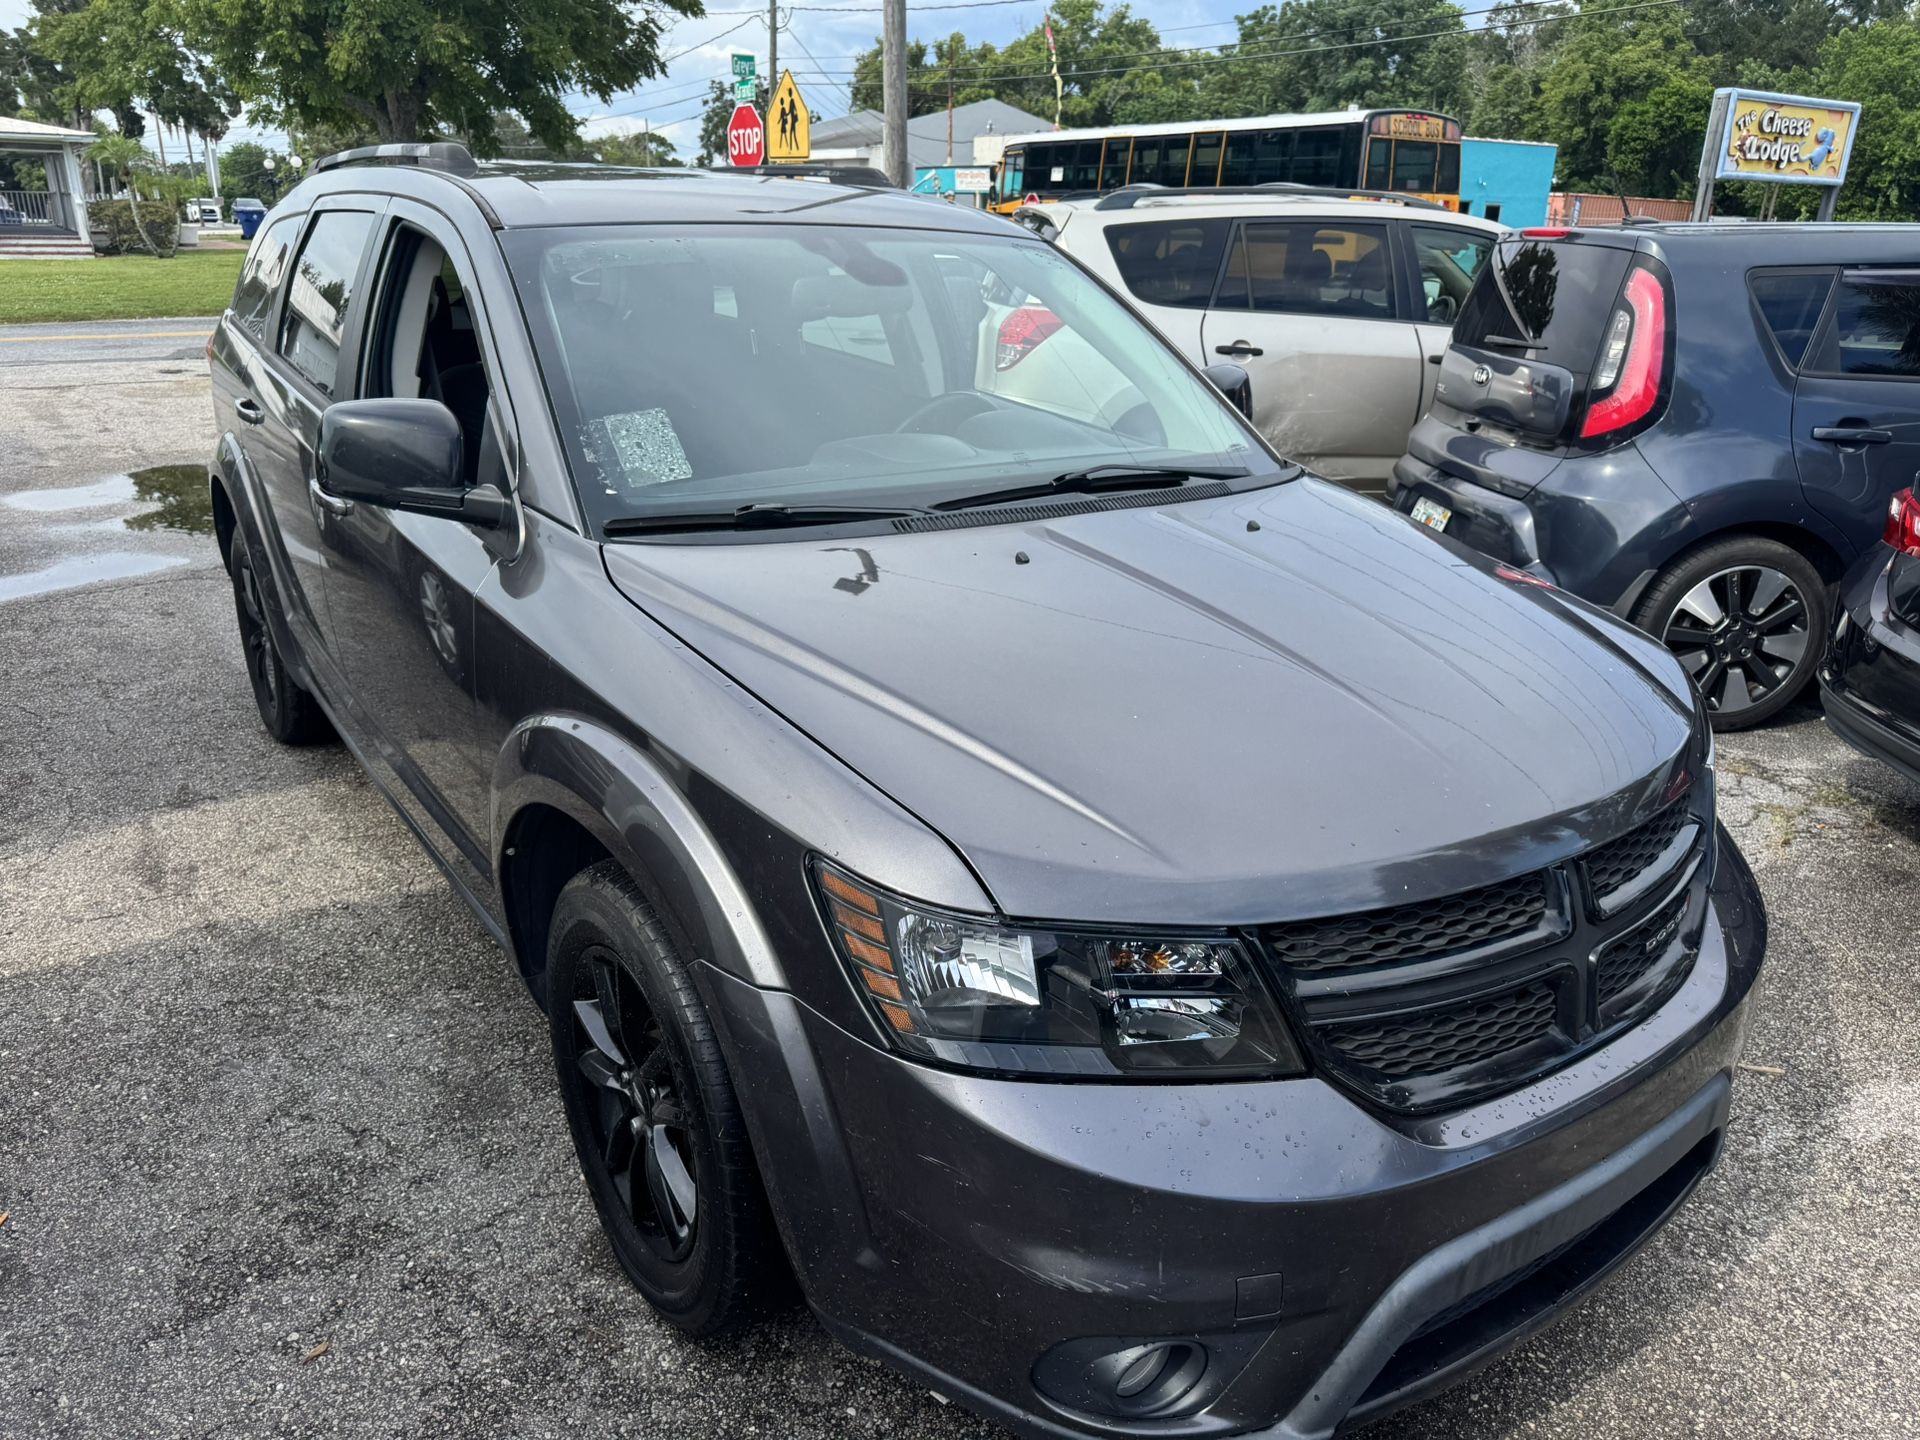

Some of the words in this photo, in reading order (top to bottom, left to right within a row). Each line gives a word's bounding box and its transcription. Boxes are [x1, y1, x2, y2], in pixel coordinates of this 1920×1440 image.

[1393, 118, 1421, 137] SCHOOL
[1425, 121, 1440, 138] BUS
[1737, 110, 1757, 130] The
[1761, 109, 1812, 137] Cheese
[731, 127, 760, 155] STOP
[1745, 136, 1799, 169] Lodge
